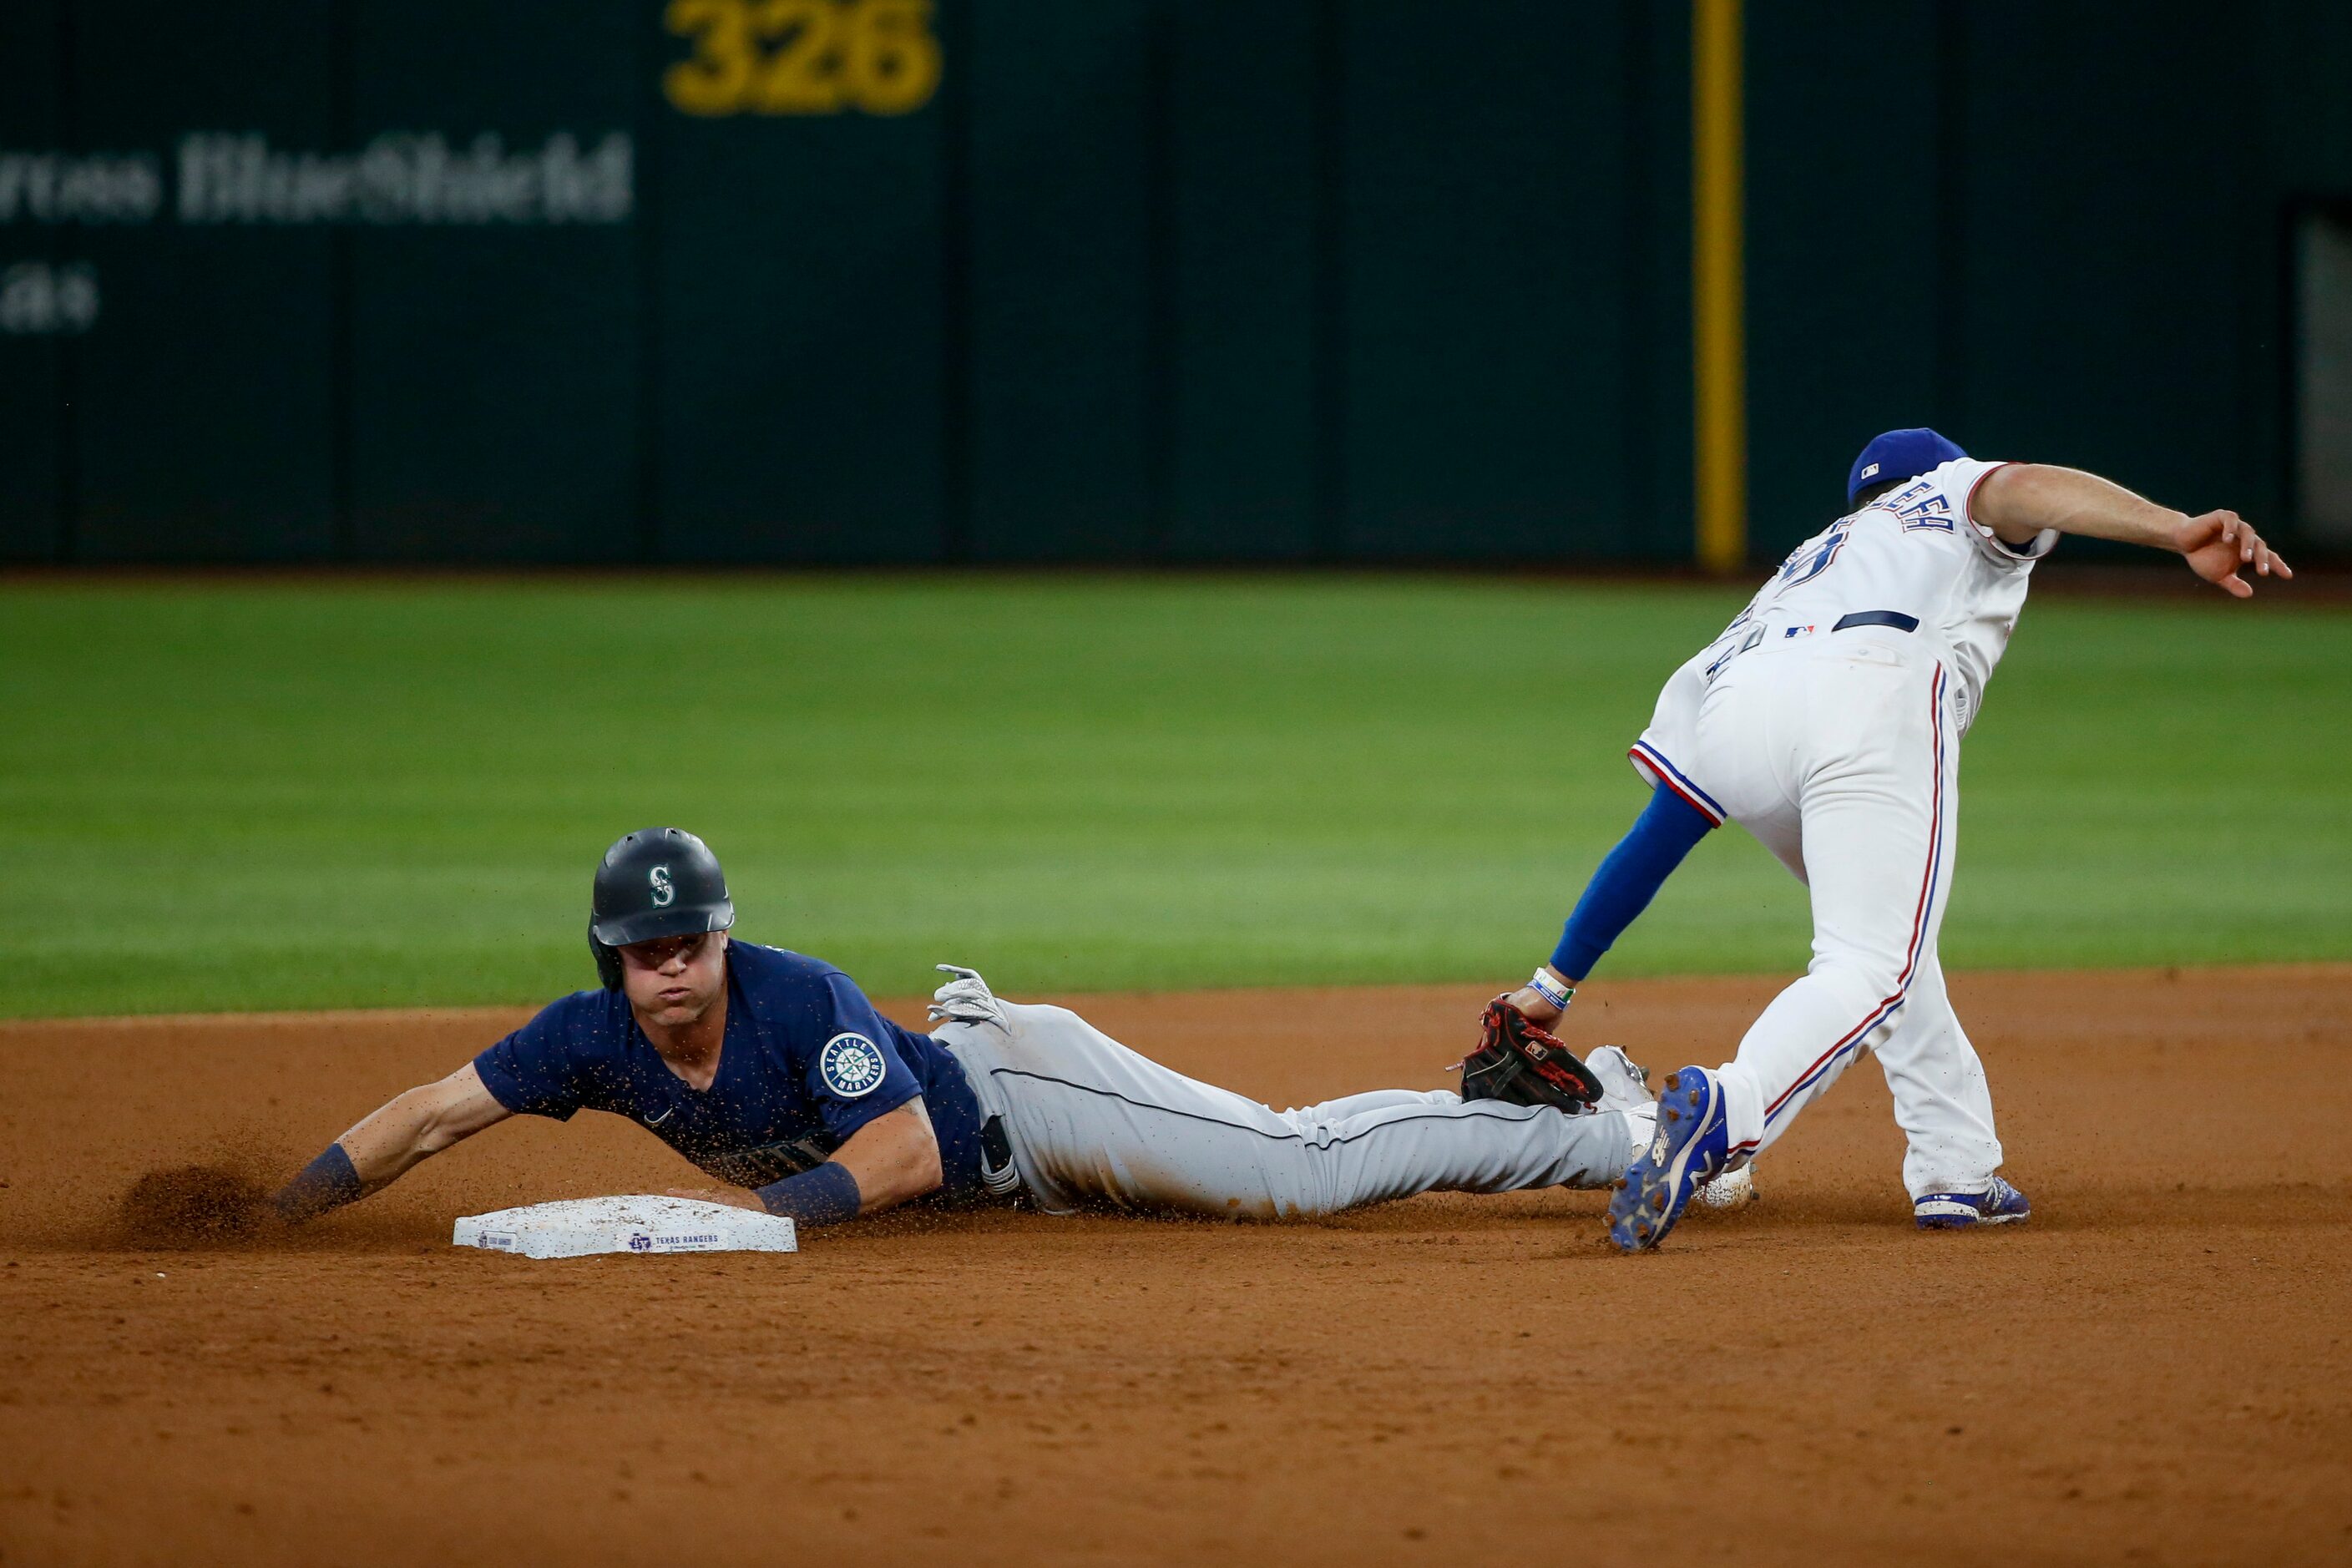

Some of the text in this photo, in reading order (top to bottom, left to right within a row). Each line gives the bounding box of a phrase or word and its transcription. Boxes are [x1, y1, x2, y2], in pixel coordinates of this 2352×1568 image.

[665, 0, 942, 114] 326
[178, 132, 633, 223] BlueShield
[648, 863, 675, 908] S
[826, 1039, 867, 1072] SEATTLE
[837, 1057, 880, 1091] MARINERS
[655, 1235, 719, 1245] TEXAS RANGERS
